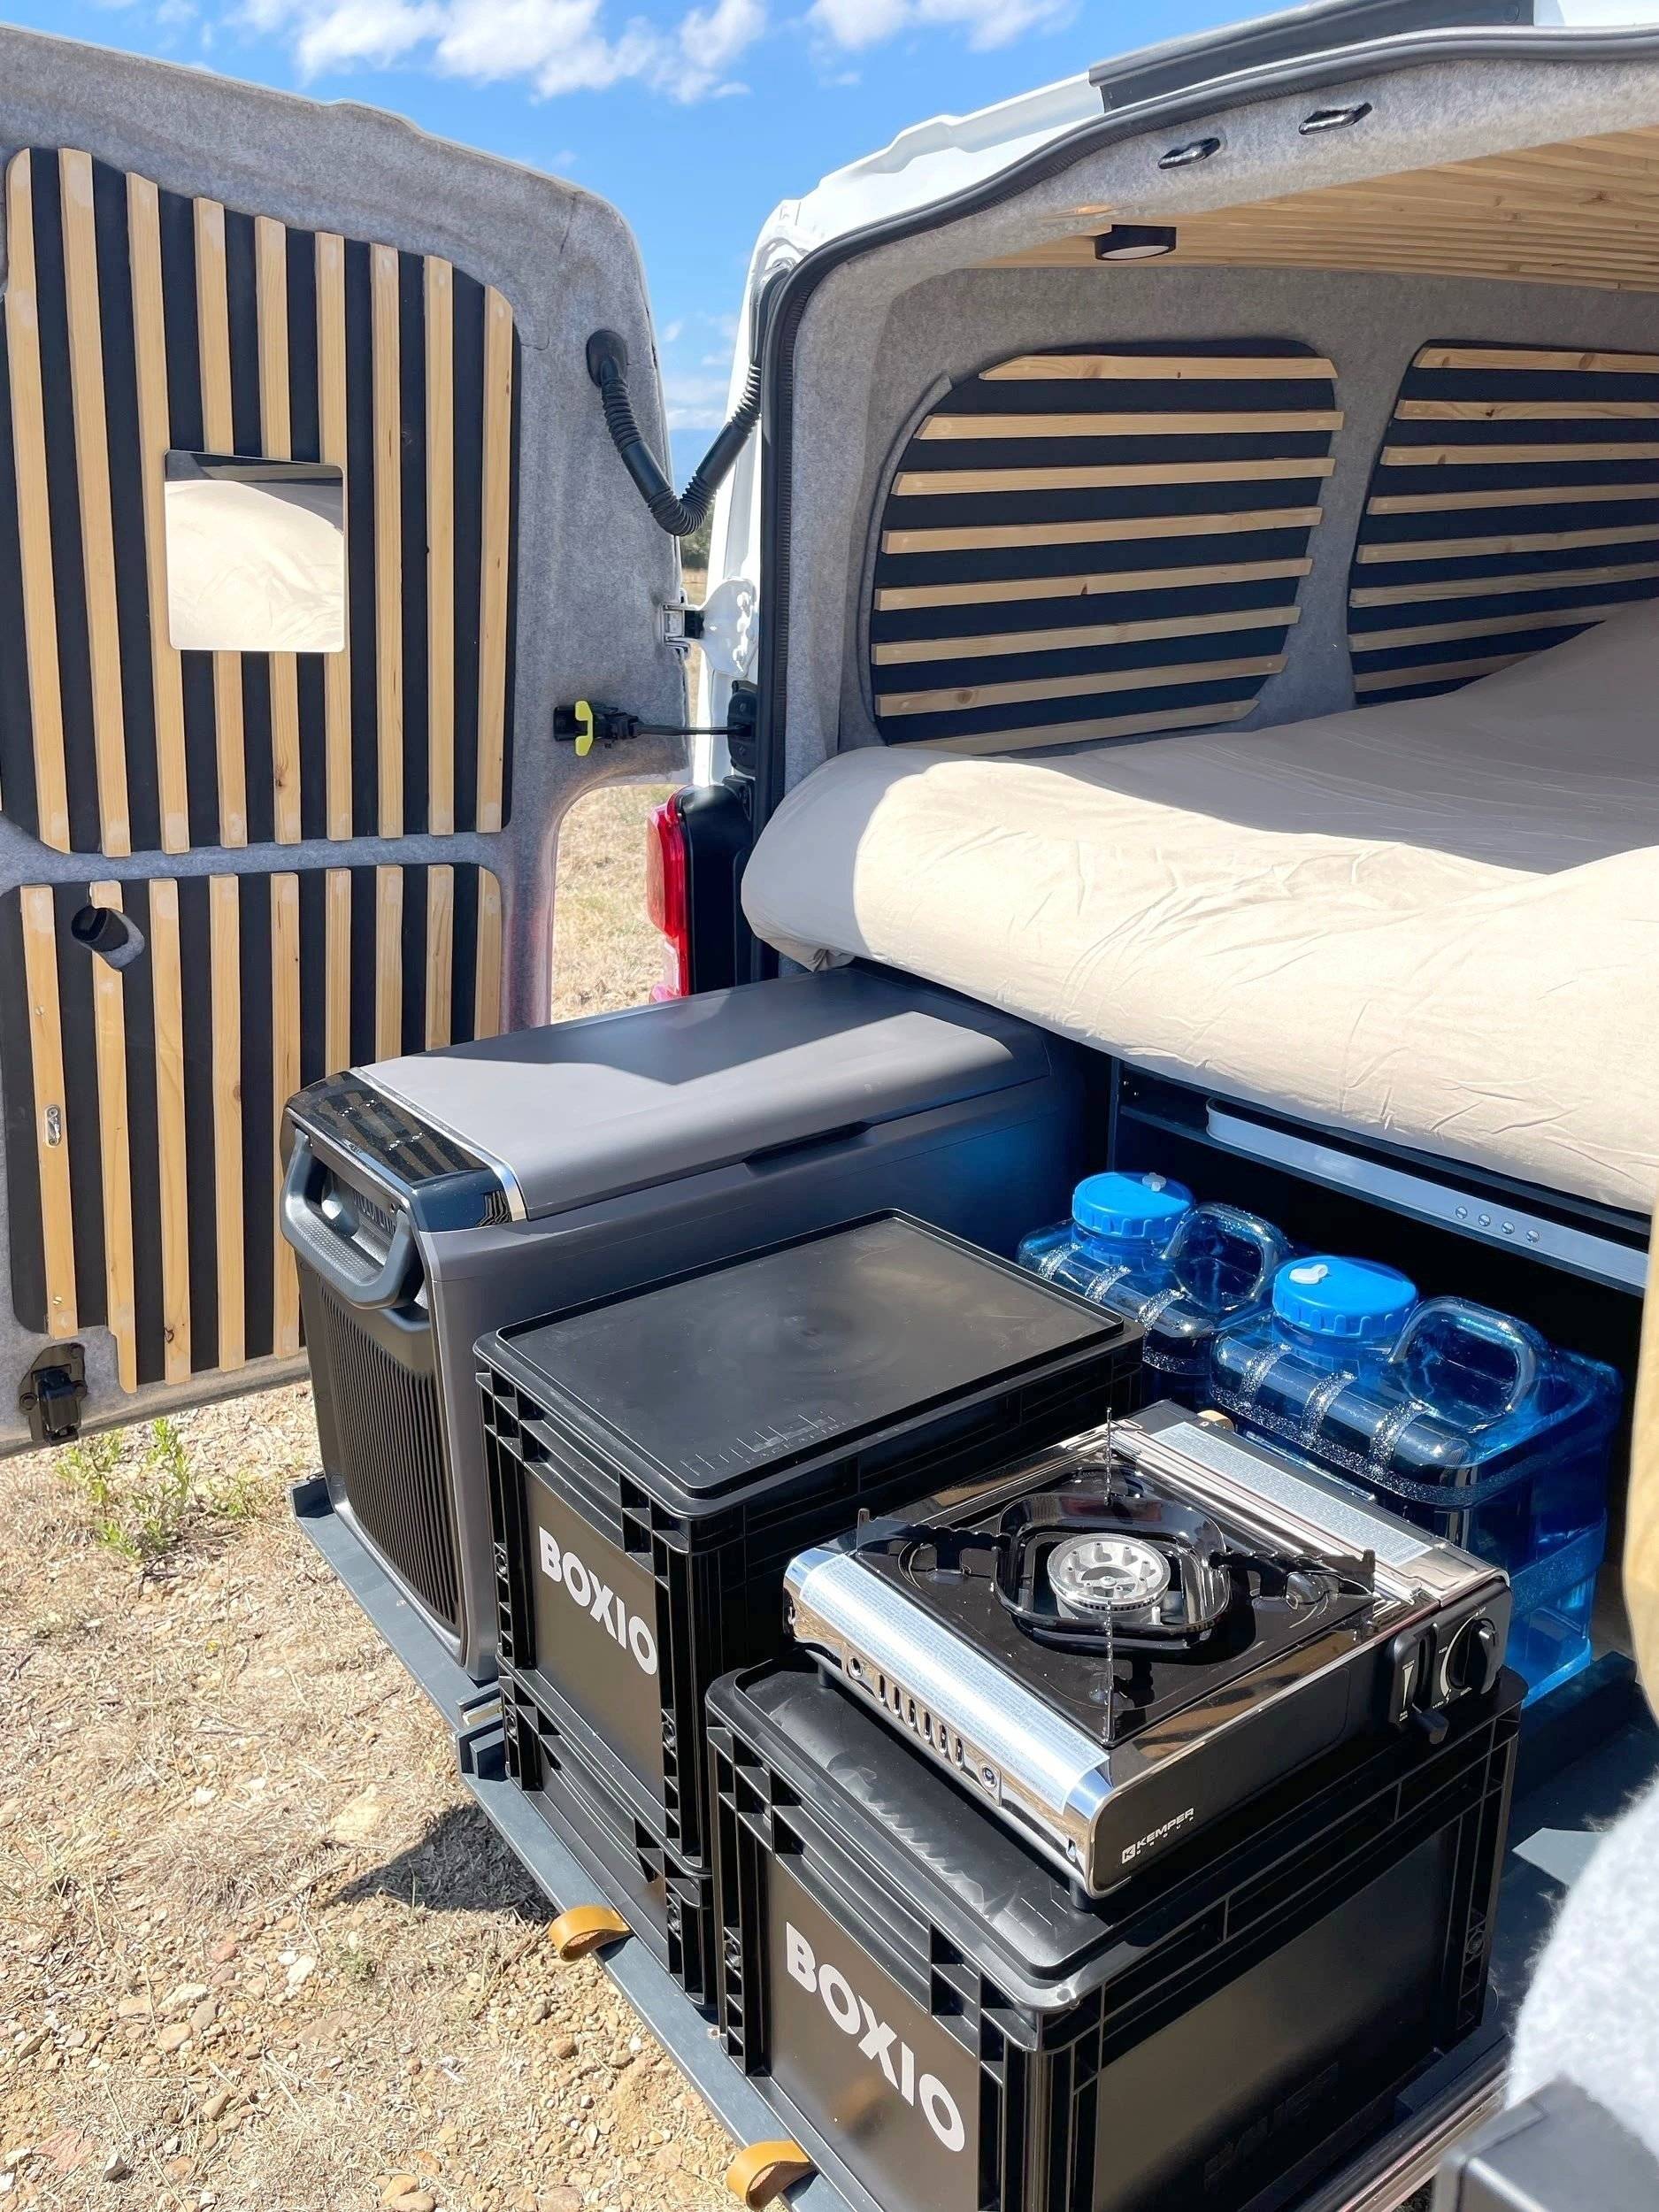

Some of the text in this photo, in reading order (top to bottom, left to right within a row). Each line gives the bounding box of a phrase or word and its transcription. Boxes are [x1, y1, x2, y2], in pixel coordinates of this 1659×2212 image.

[539, 1525, 657, 1675] BOXIO
[1136, 1808, 1194, 1849] KEMPER
[786, 1921, 965, 2153] BOXIO
